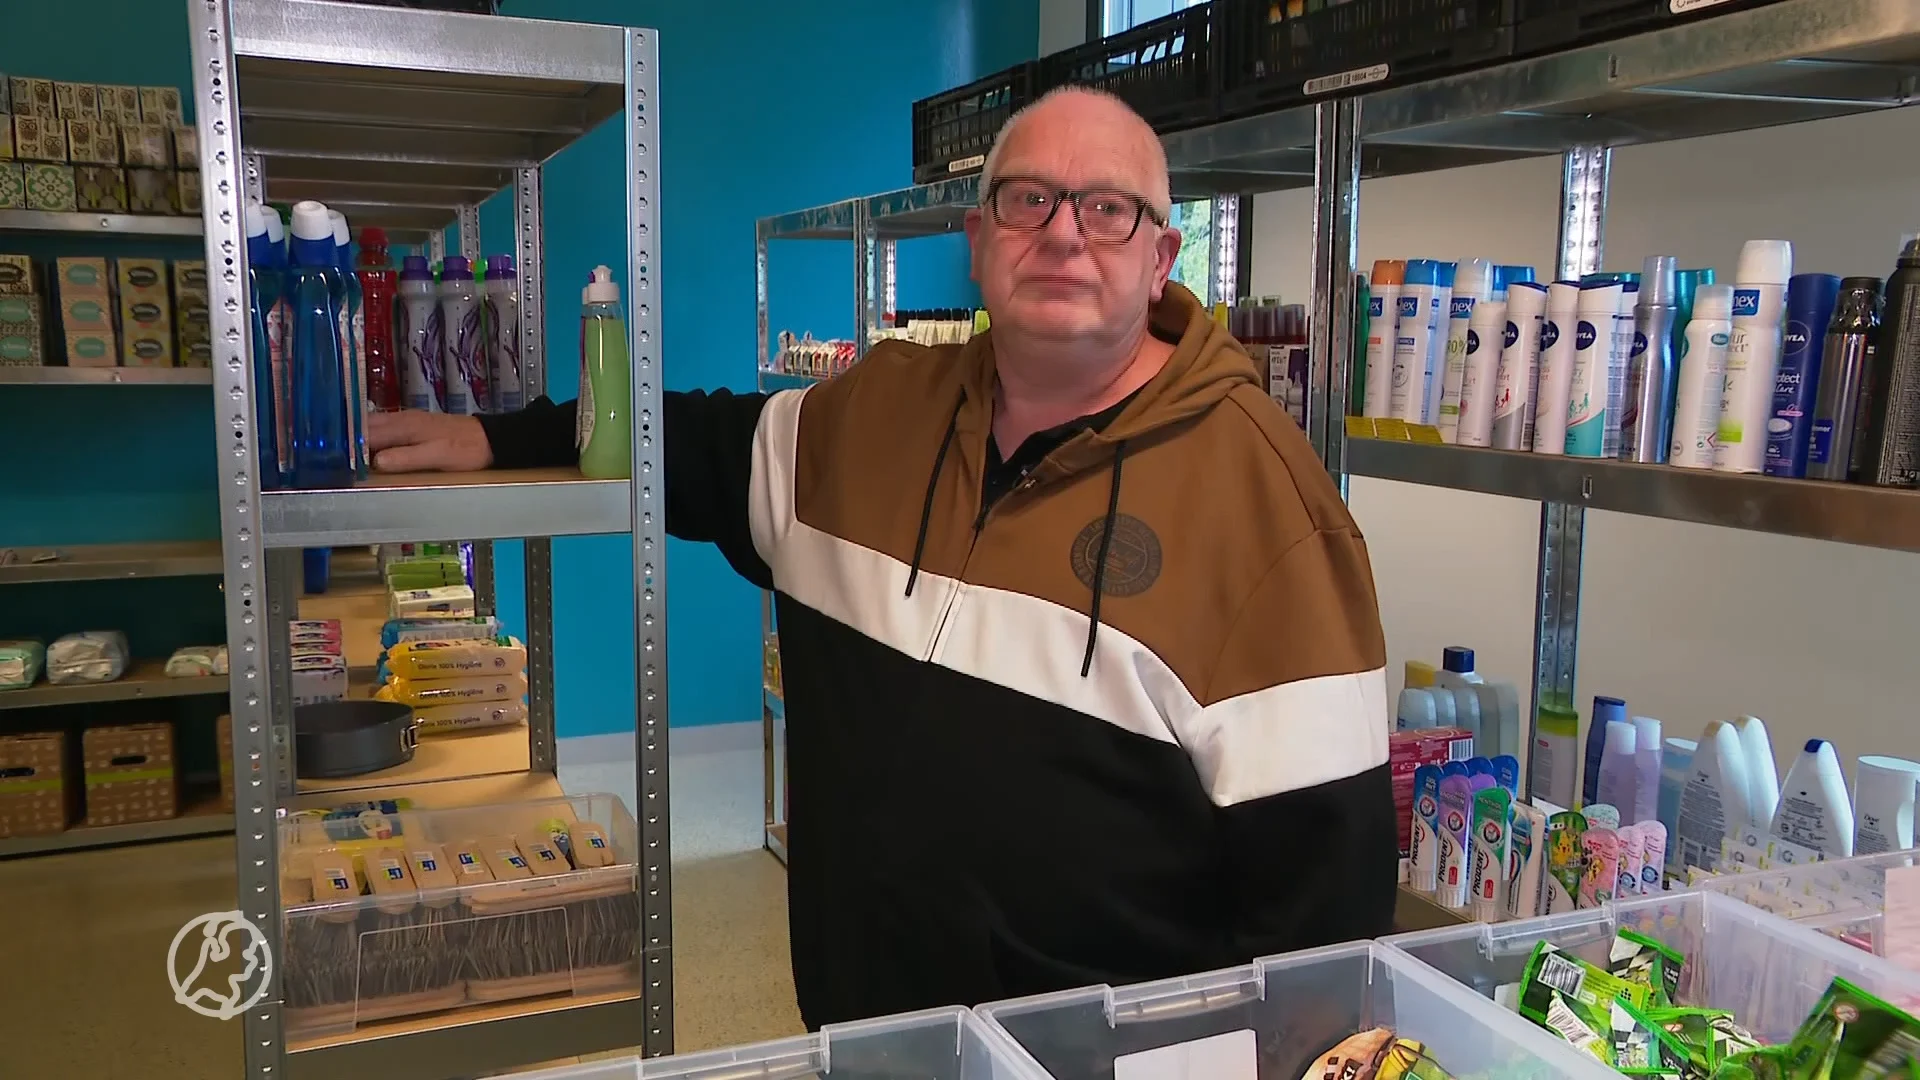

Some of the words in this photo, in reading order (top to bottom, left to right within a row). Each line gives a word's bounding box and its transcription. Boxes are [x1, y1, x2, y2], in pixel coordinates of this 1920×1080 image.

[1452, 302, 1472, 312] nex
[1775, 373, 1800, 384] otect
[1411, 824, 1421, 867] PRODENT
[1438, 838, 1449, 882] PRODENT
[1472, 850, 1485, 896] PRODENT
